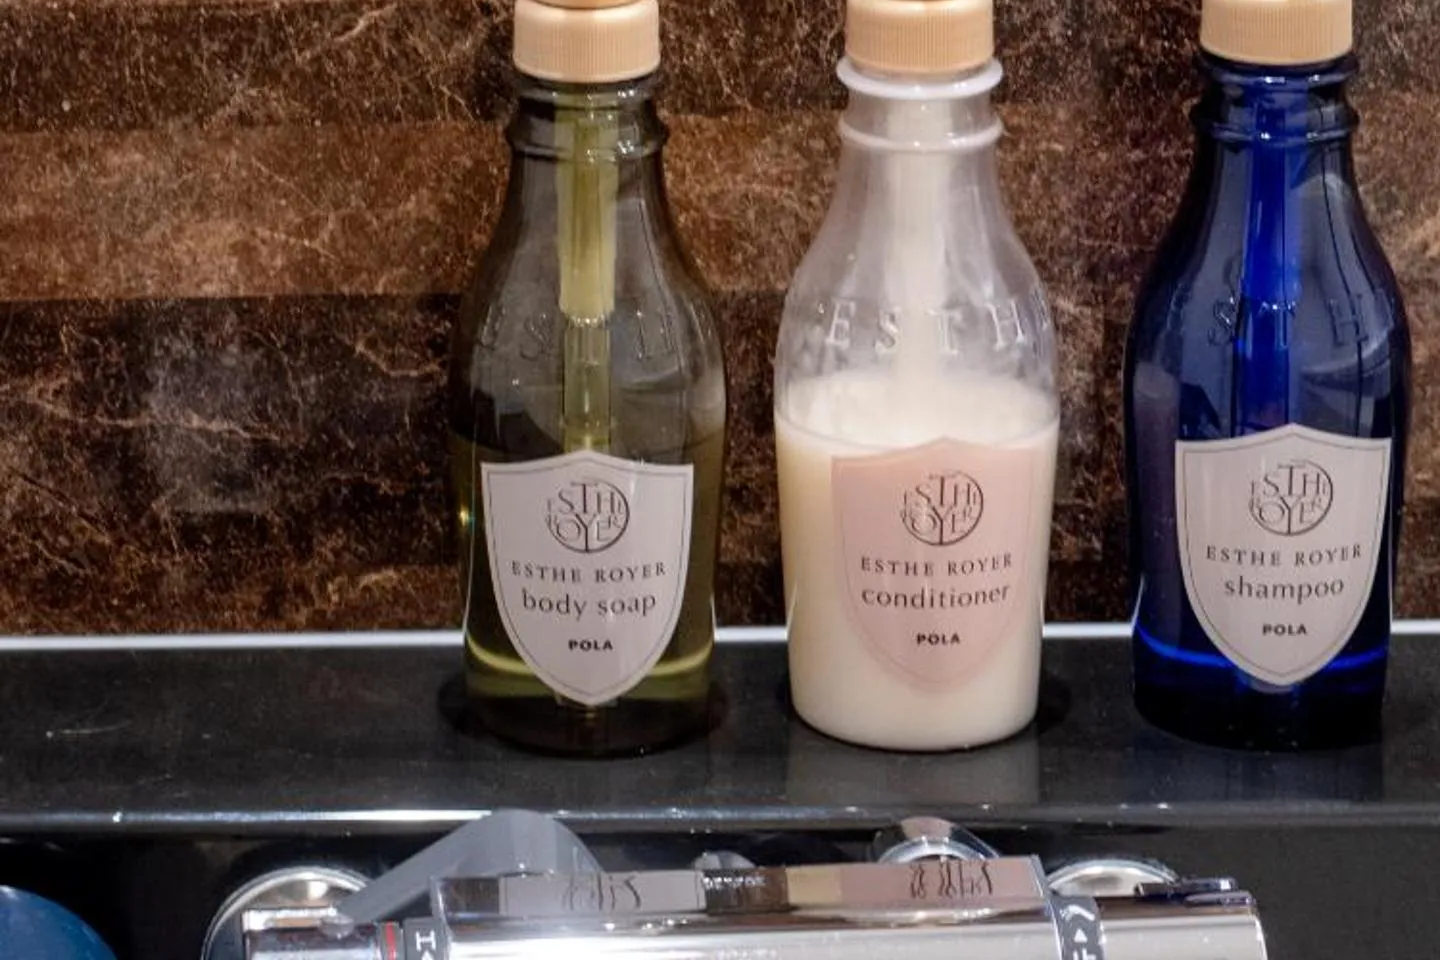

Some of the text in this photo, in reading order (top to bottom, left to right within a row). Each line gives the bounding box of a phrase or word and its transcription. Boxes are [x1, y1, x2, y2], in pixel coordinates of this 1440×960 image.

[861, 552, 1012, 577] ESTHE ROYER
[1206, 543, 1362, 567] ESTHE ROYER
[511, 560, 667, 583] ESTHE ROYER
[861, 585, 1010, 610] conditioner
[1224, 575, 1345, 605] shampoo
[522, 588, 657, 621] body soap
[916, 632, 961, 646] POLA
[1262, 623, 1308, 637] POLA
[567, 639, 614, 652] POLA
